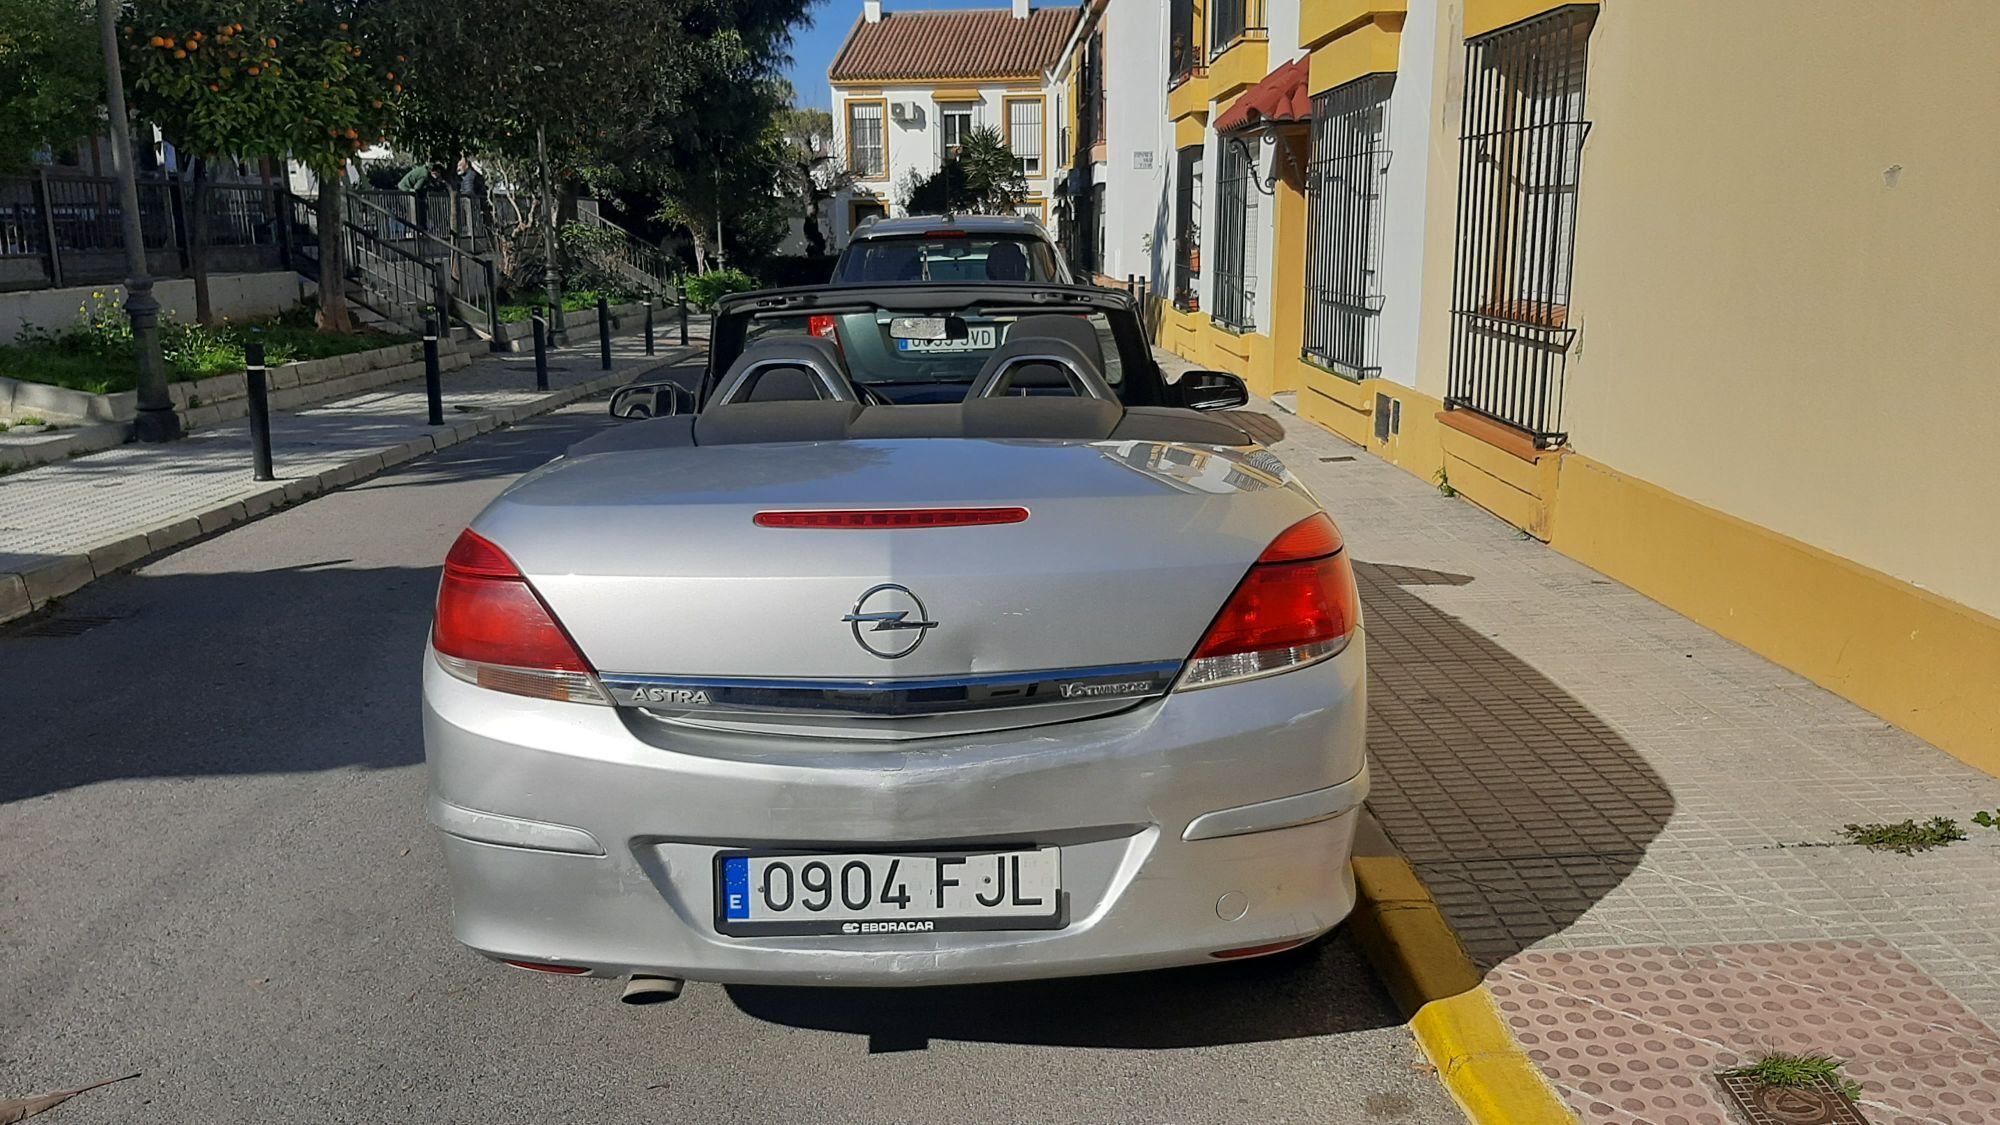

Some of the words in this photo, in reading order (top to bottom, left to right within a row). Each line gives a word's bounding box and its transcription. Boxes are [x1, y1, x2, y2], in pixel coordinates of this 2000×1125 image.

[631, 687, 713, 705] ASTRA
[763, 859, 911, 912] 0904
[935, 855, 1043, 909] FJL
[729, 894, 742, 909] E
[861, 921, 935, 933] EBORACAR
